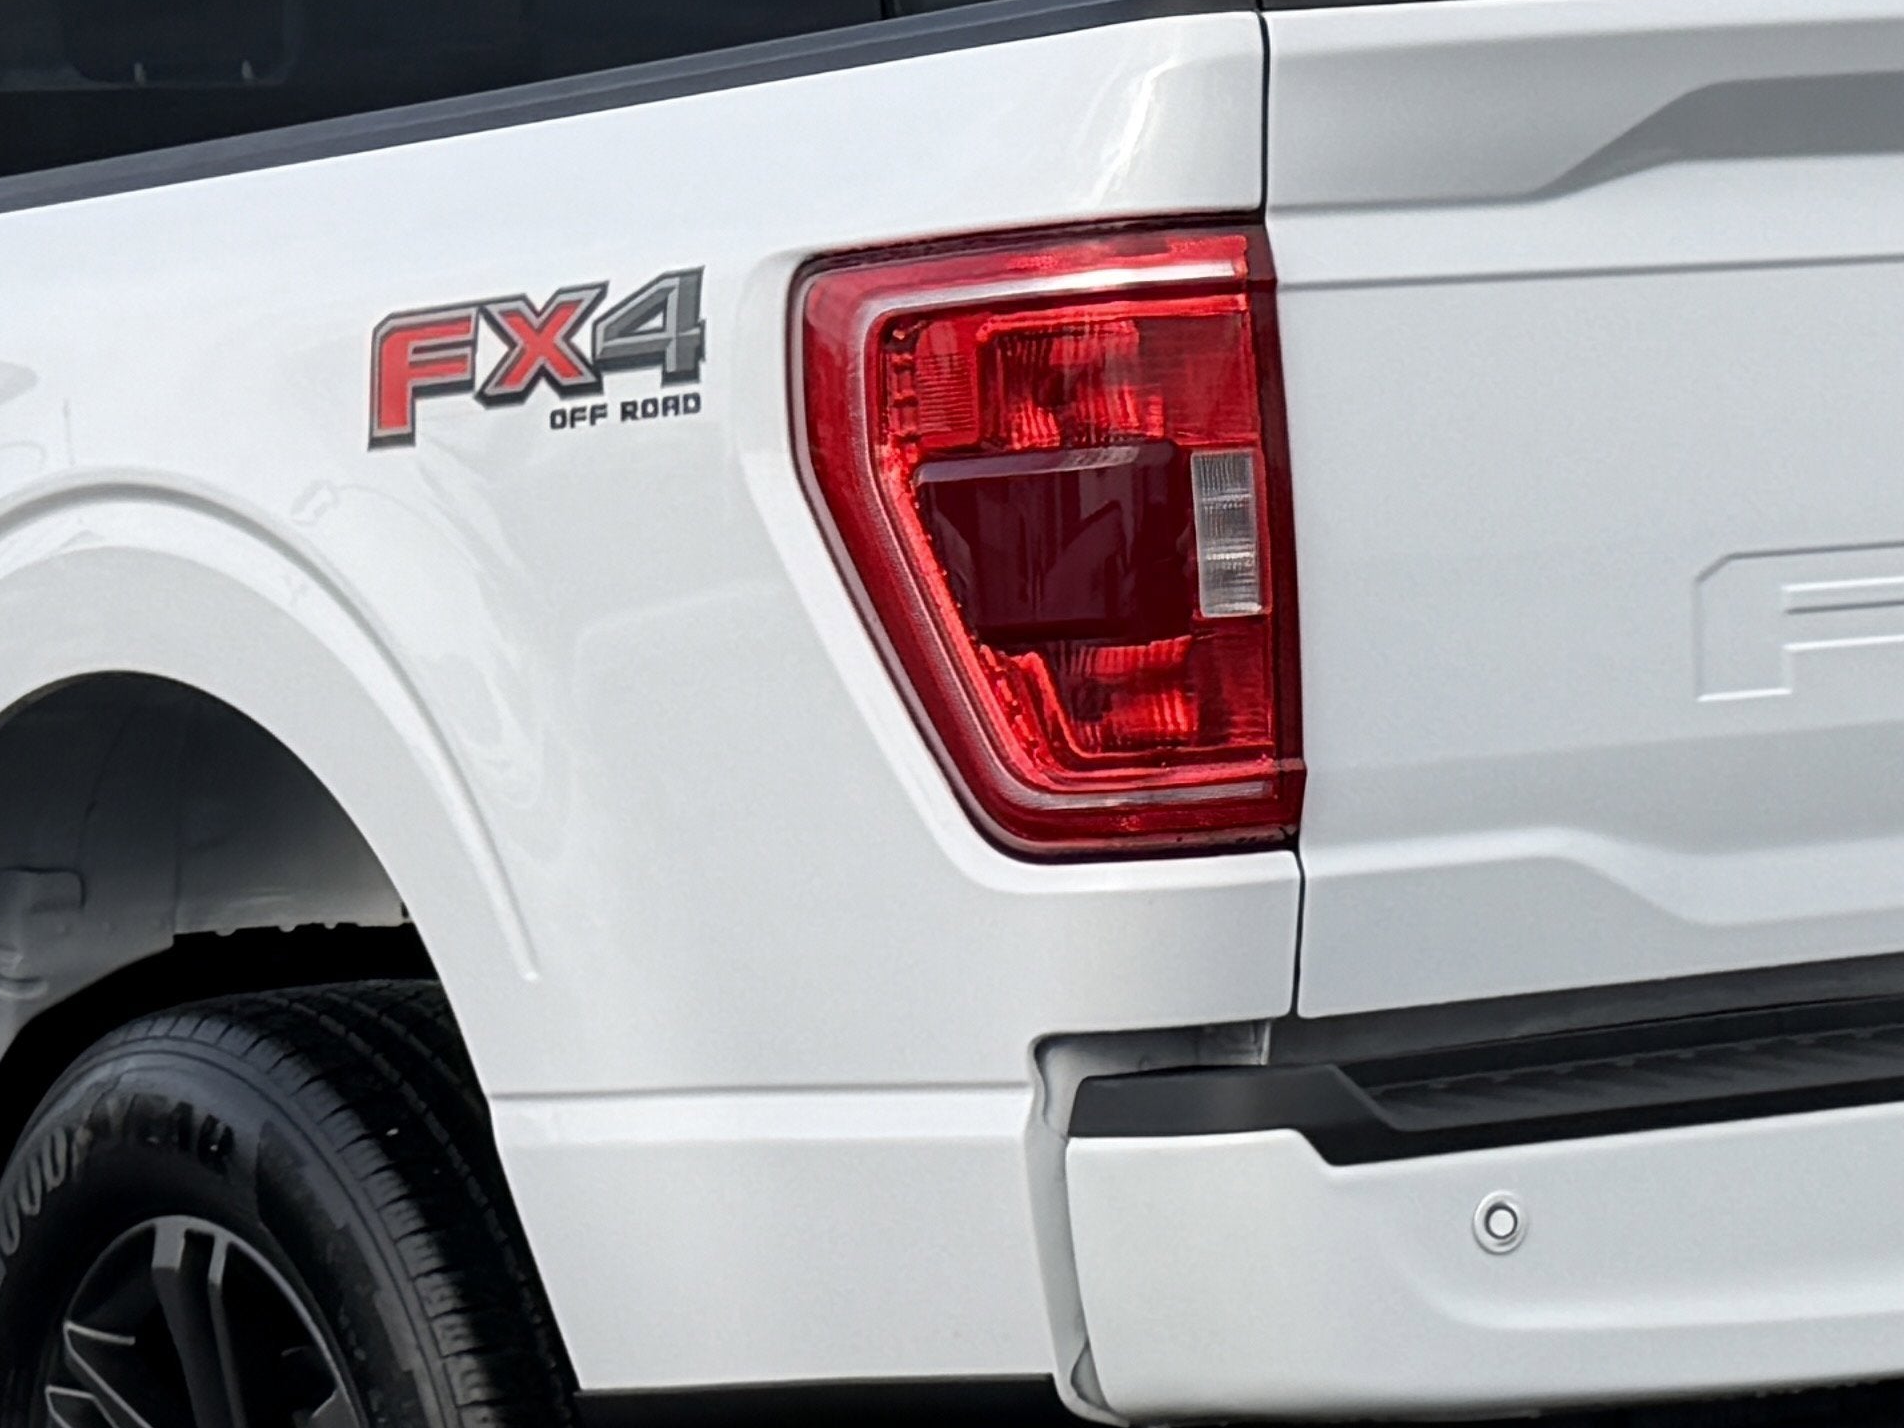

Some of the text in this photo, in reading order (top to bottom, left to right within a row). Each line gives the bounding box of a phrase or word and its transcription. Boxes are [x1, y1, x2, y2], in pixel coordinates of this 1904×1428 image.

[367, 265, 706, 451] FX4
[549, 392, 702, 430] OFF ROAD
